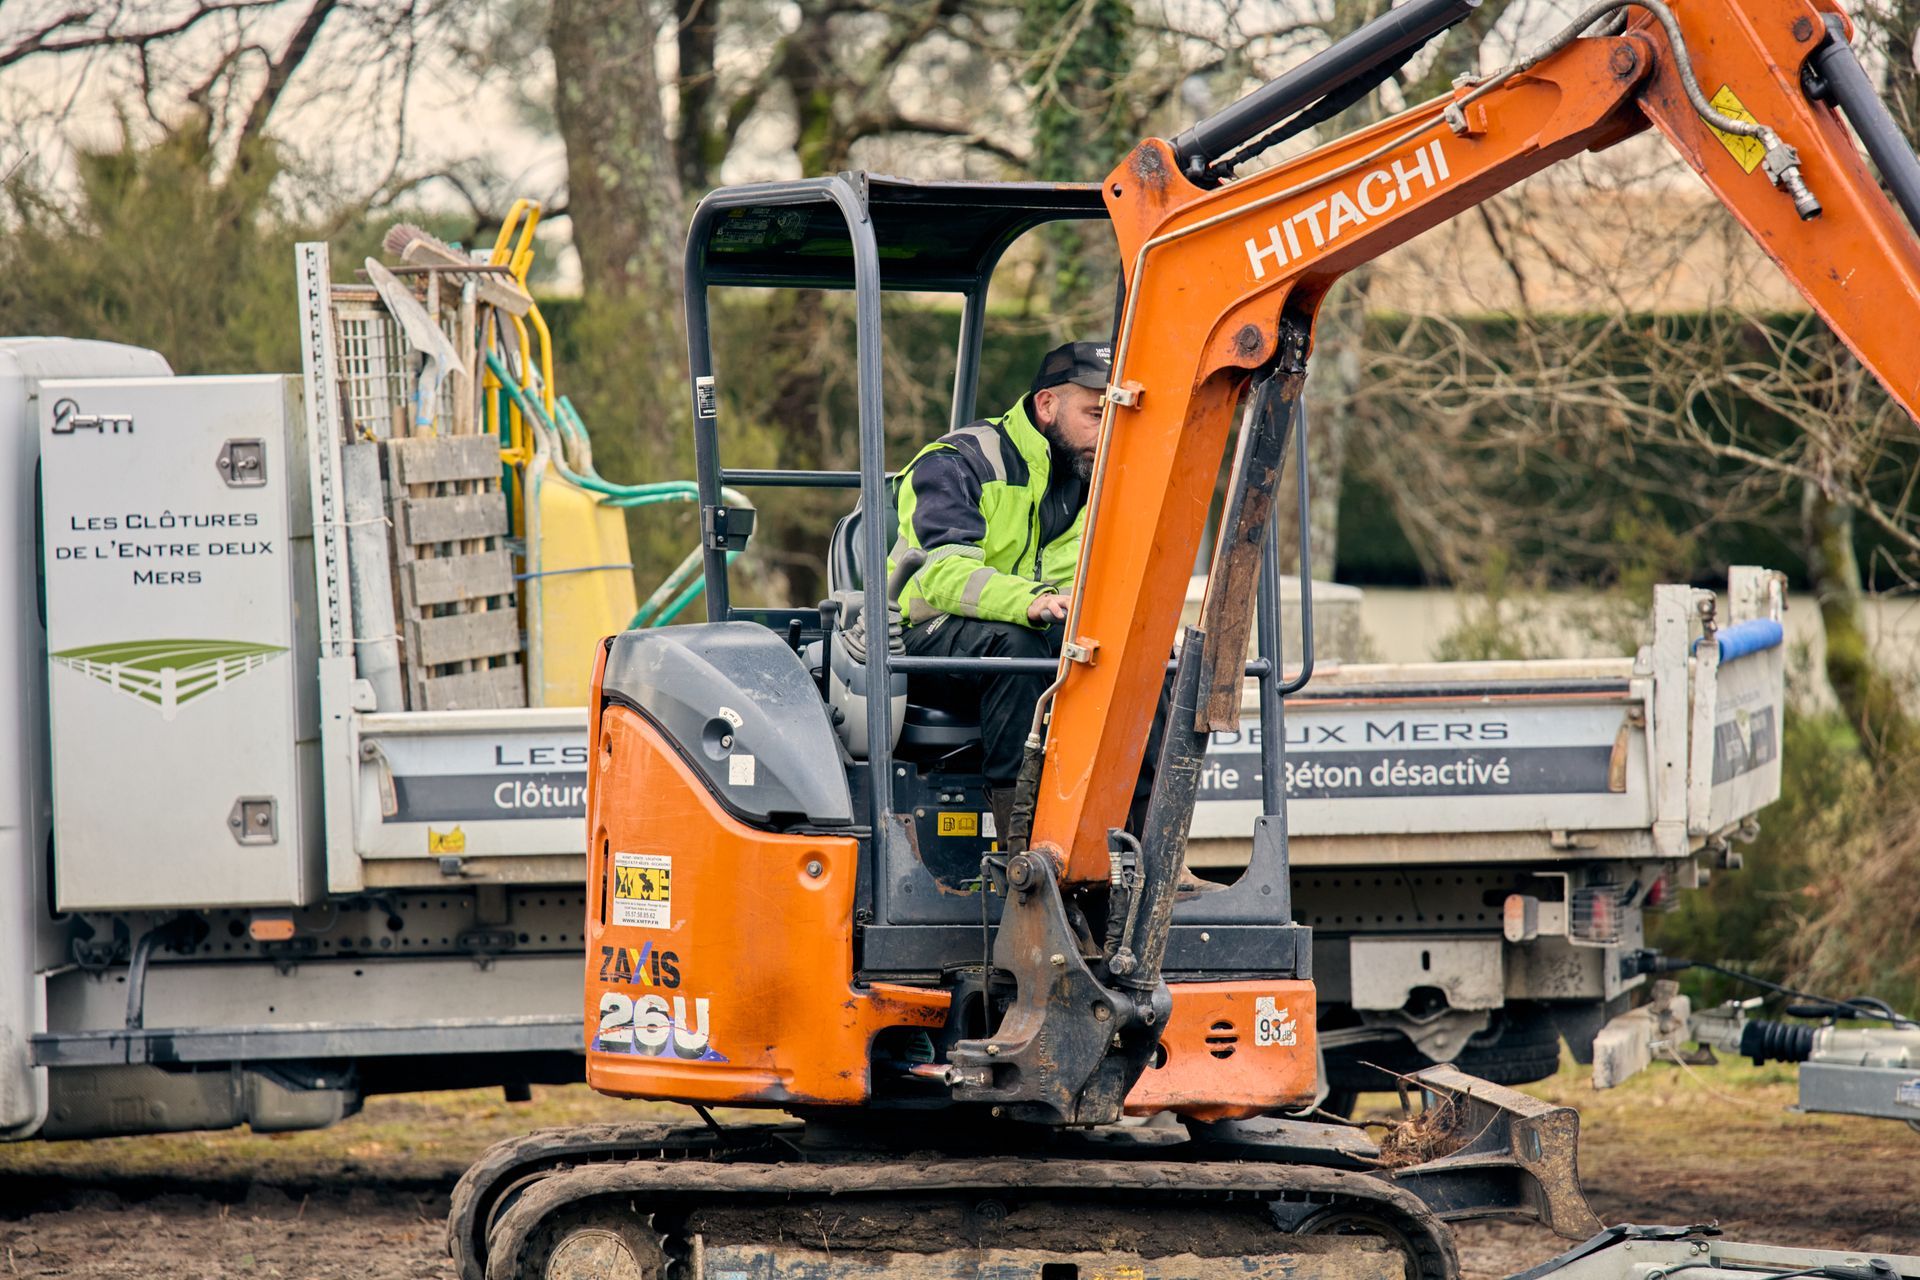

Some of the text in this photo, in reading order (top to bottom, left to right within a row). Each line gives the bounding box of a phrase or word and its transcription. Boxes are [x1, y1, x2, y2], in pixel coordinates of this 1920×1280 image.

[1244, 138, 1450, 280] HITACHI
[70, 515, 118, 531] LES
[133, 570, 202, 585] MERS
[1366, 721, 1509, 742] MERS
[1370, 757, 1510, 787] désactivé
[600, 941, 680, 989] ZAXIS
[599, 992, 710, 1059] 26U
[1260, 1018, 1281, 1041] 93
